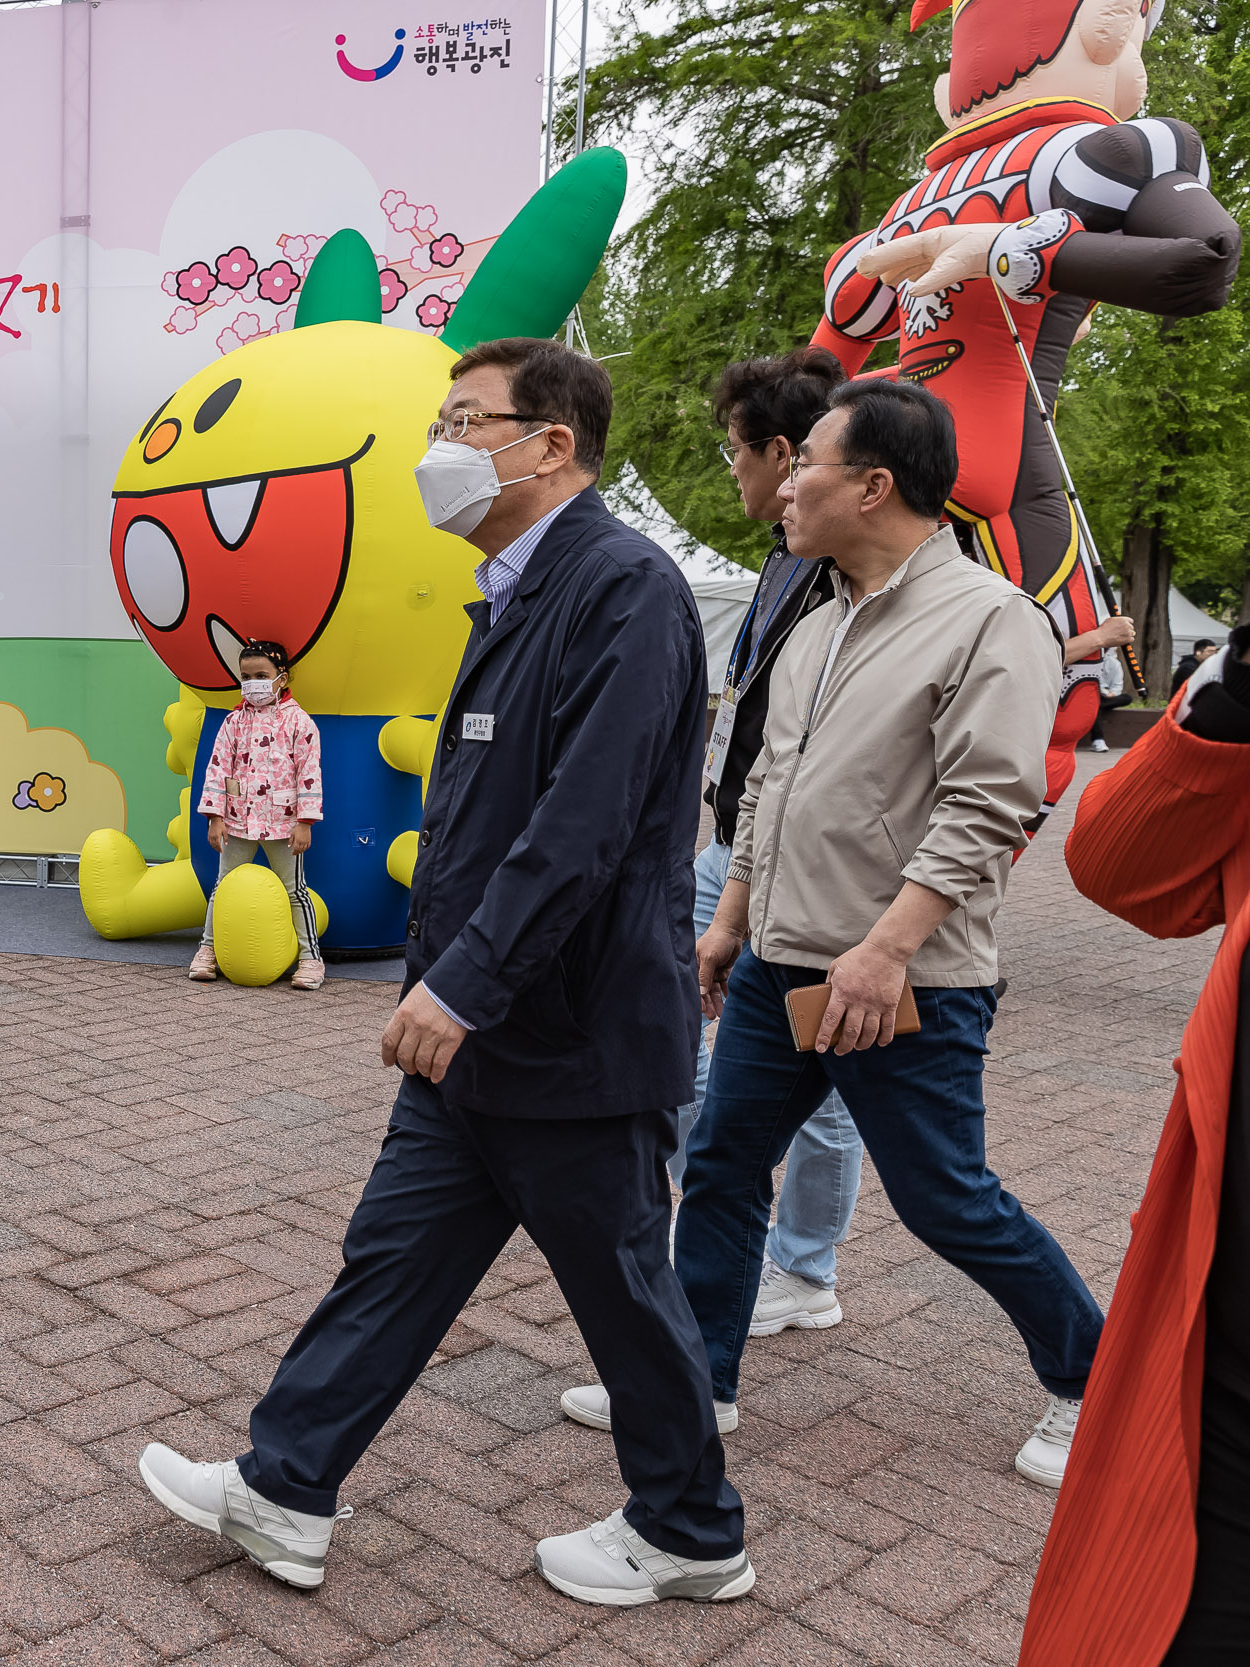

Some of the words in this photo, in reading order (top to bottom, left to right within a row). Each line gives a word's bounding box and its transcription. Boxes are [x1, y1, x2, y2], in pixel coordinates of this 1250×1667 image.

[414, 22, 460, 44] 소통하며
[462, 18, 512, 41] 발전하는
[413, 39, 511, 76] 행복광진
[713, 731, 727, 748] STAFF
